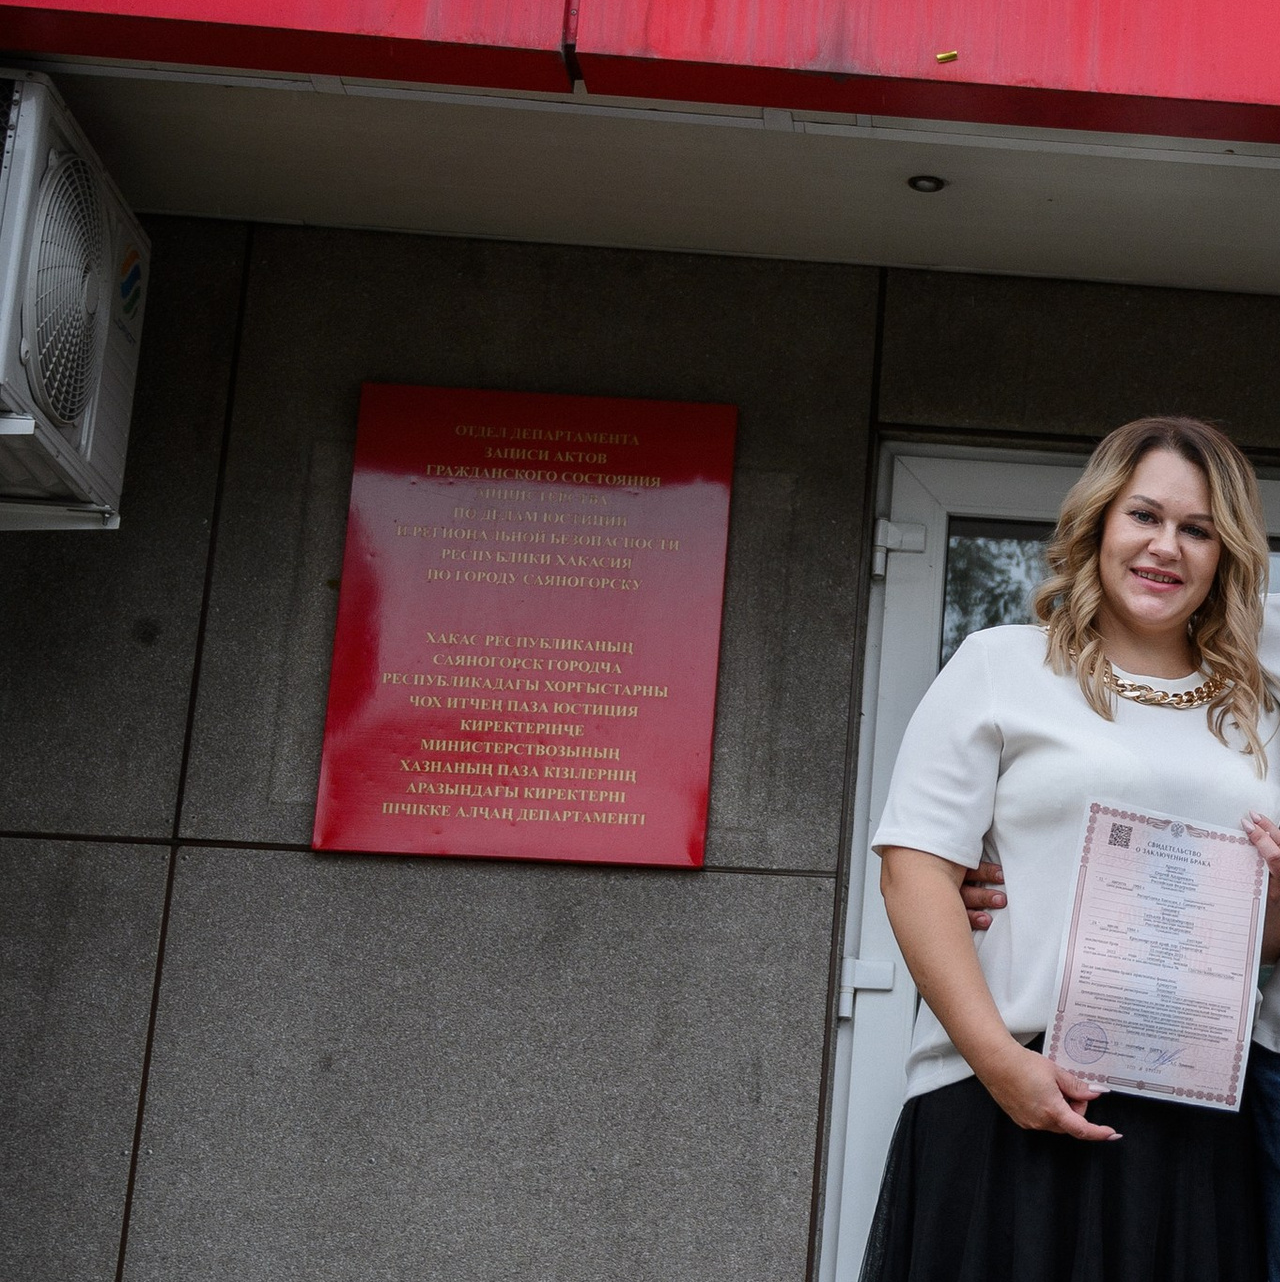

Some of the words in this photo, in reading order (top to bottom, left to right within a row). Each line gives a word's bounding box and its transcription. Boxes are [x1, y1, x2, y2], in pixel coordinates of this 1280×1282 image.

[455, 424, 507, 439] ОТДЕЛ
[510, 427, 640, 446] ДЕПАРТАМЕНТА
[484, 448, 549, 462] ЗАПИСИ
[553, 451, 607, 464] АКТОВ
[426, 464, 558, 482] ГРАЖДАНСКОГО
[560, 472, 661, 487] СОСТОЯНИЯ
[454, 507, 477, 519] ПО
[543, 512, 628, 527] ЮСТИЦИИ
[550, 532, 680, 551] БЕЗОПАСНОСТИ
[441, 548, 552, 565] РЕСПУБЛИКИ
[555, 553, 632, 569] ХАКАСИЯ
[427, 568, 451, 581] ПО
[455, 569, 519, 585] ГОРОДУ
[523, 573, 642, 591] САЯНОГОРСКУ
[426, 631, 480, 645] ХАКАС
[432, 653, 543, 670] САЯНОГОРСК
[548, 659, 622, 674] ГОРОДЧА
[410, 695, 442, 708] ЧОХ
[507, 699, 548, 713] ПАЗА
[553, 702, 639, 718] ЮСТИЦИЯ
[498, 764, 540, 778] ПАЗА
[1141, 848, 1189, 864] ЗАКЛЮЧЕНИИ
[1189, 857, 1212, 868] БРАКА
[1147, 840, 1202, 858] СВИДЕТЕЛЬСТВО
